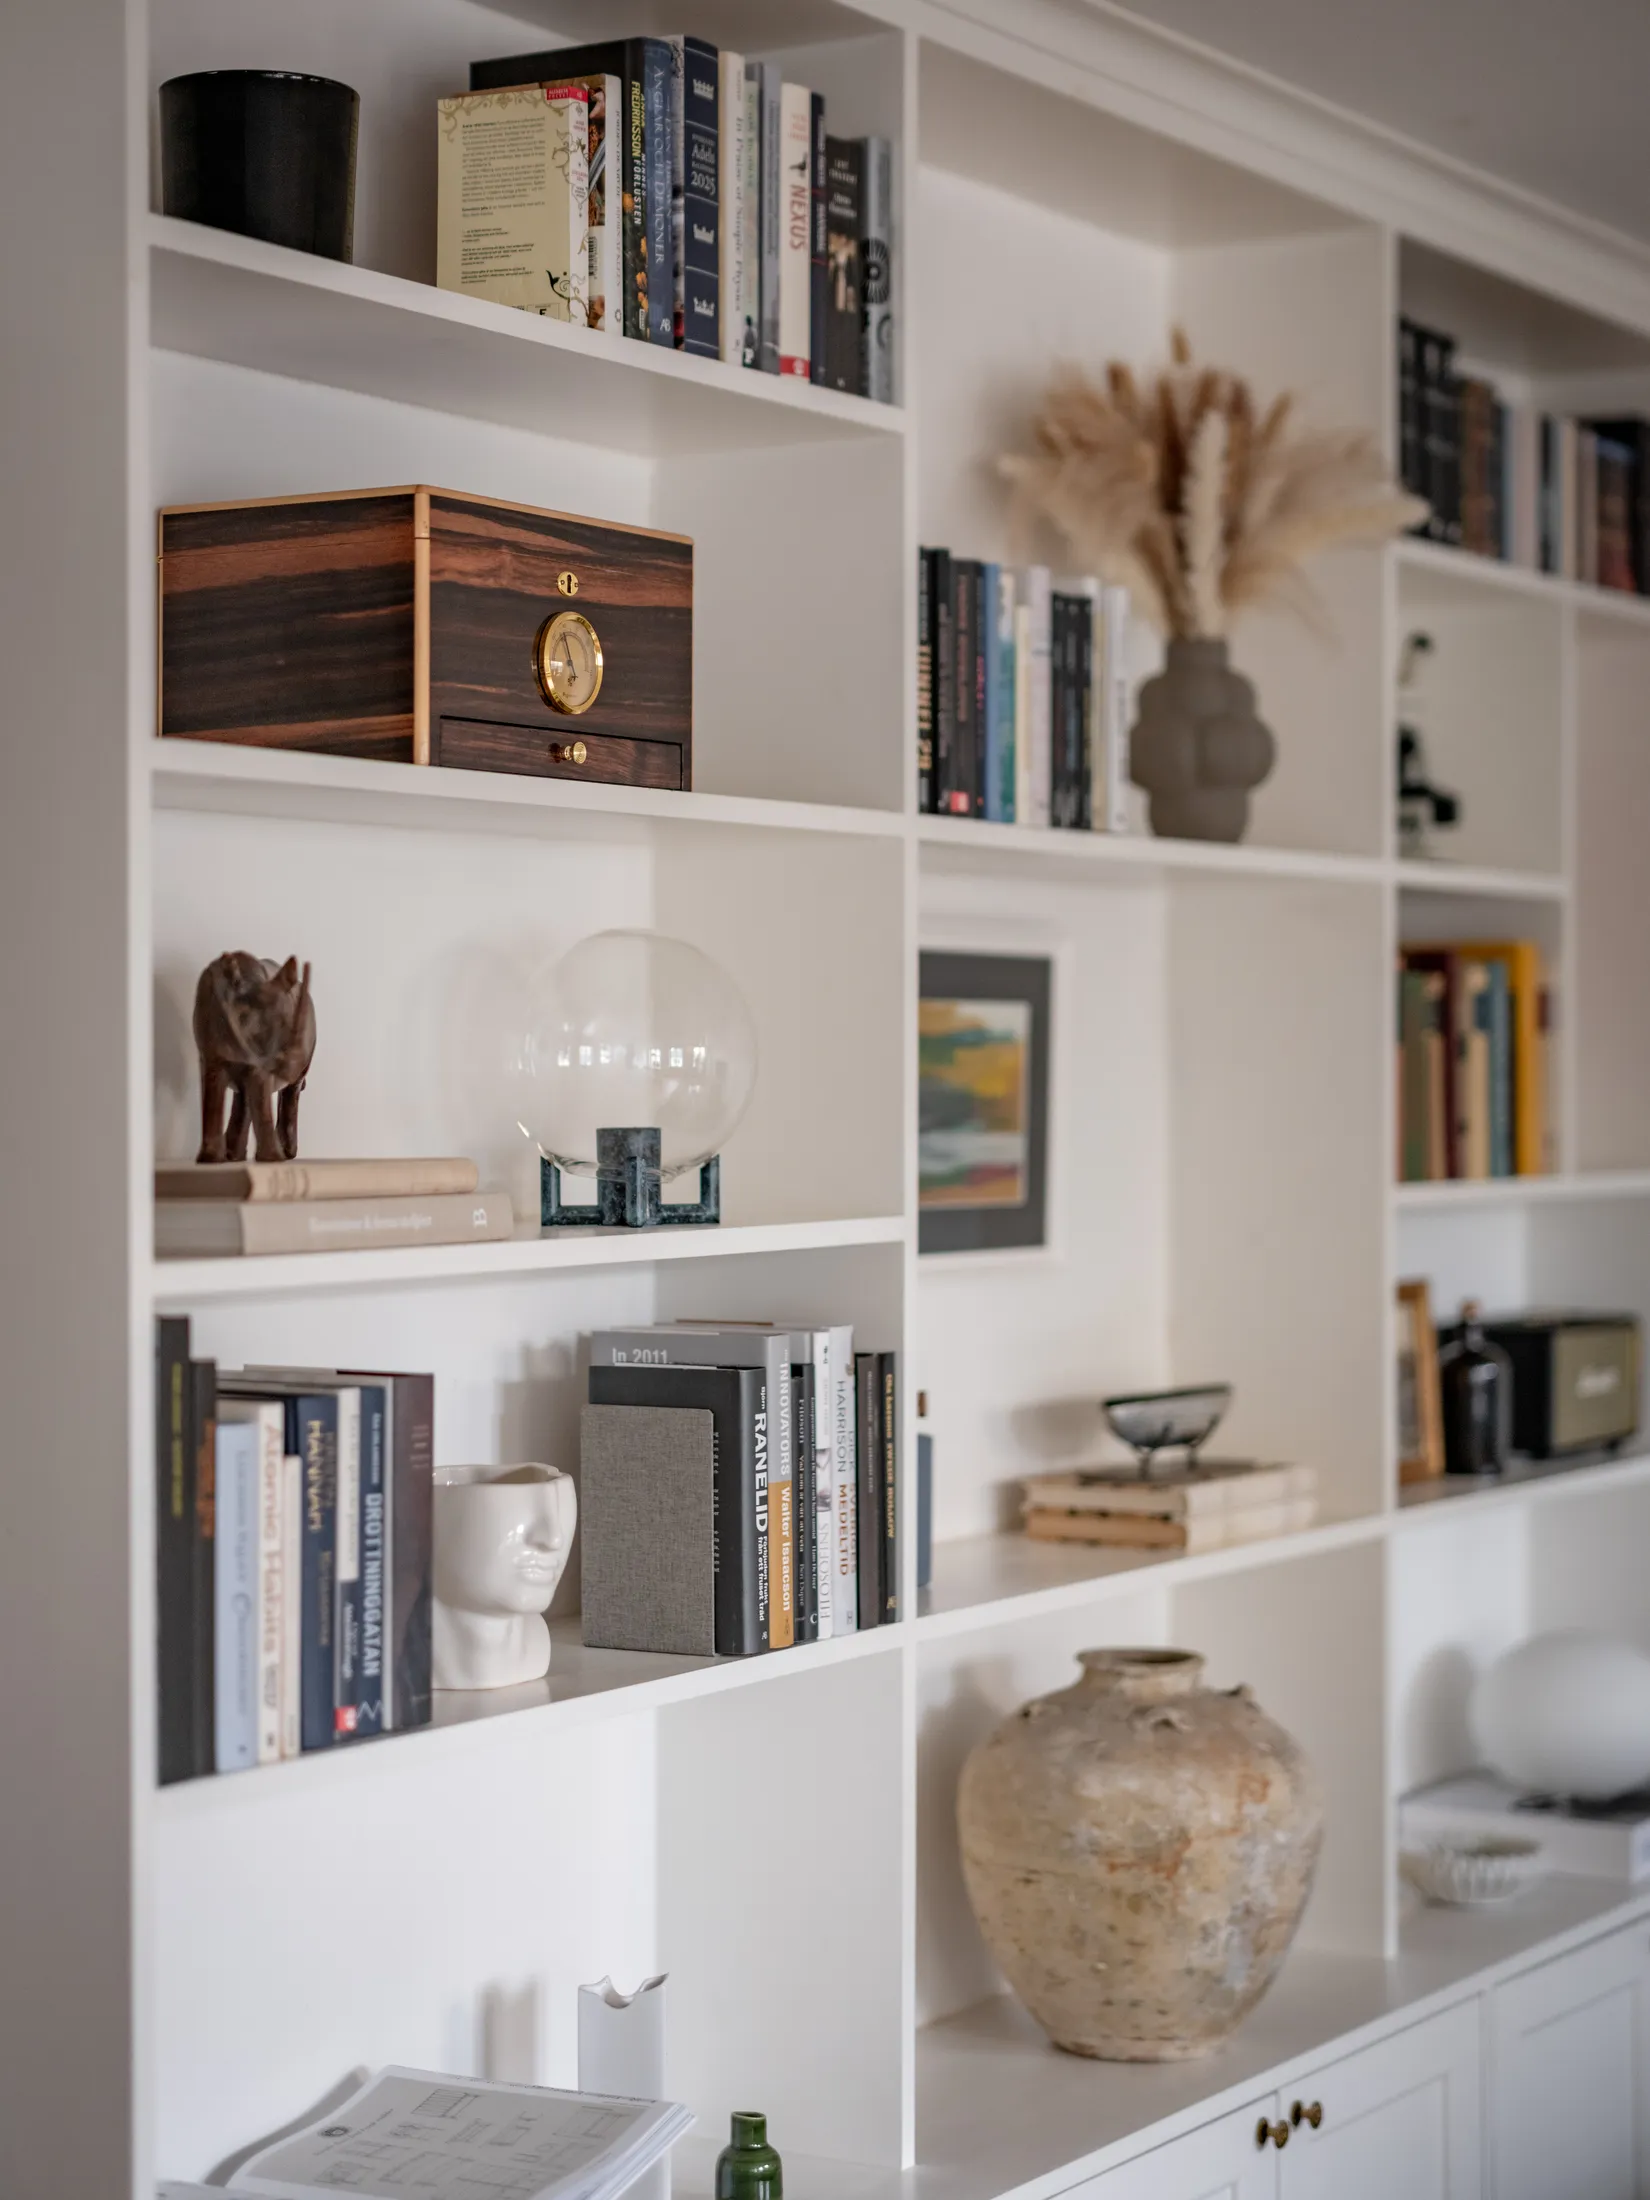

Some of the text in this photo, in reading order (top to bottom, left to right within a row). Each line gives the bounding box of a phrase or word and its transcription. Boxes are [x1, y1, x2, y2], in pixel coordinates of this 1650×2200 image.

[631, 81, 642, 157] FREDRIKSSON
[653, 138, 666, 177] OCH
[653, 181, 666, 264] DEMONER
[690, 171, 716, 196] 2025
[791, 184, 806, 252] NEXUS
[612, 1347, 627, 1363] In
[779, 1363, 791, 1475] INNOVATORS
[837, 1380, 847, 1473] HARRISON
[264, 1422, 283, 1539] Atomic
[307, 1420, 324, 1531] HANNAH
[755, 1413, 768, 1532] RANELID
[799, 1491, 805, 1501] är
[780, 1487, 793, 1611] Walter Isaacson
[819, 1523, 831, 1618] FILOSOFINS
[839, 1483, 849, 1576] MEDELTID
[264, 1549, 283, 1652] Habits
[363, 1492, 382, 1677] DROTTNINGGATAN
